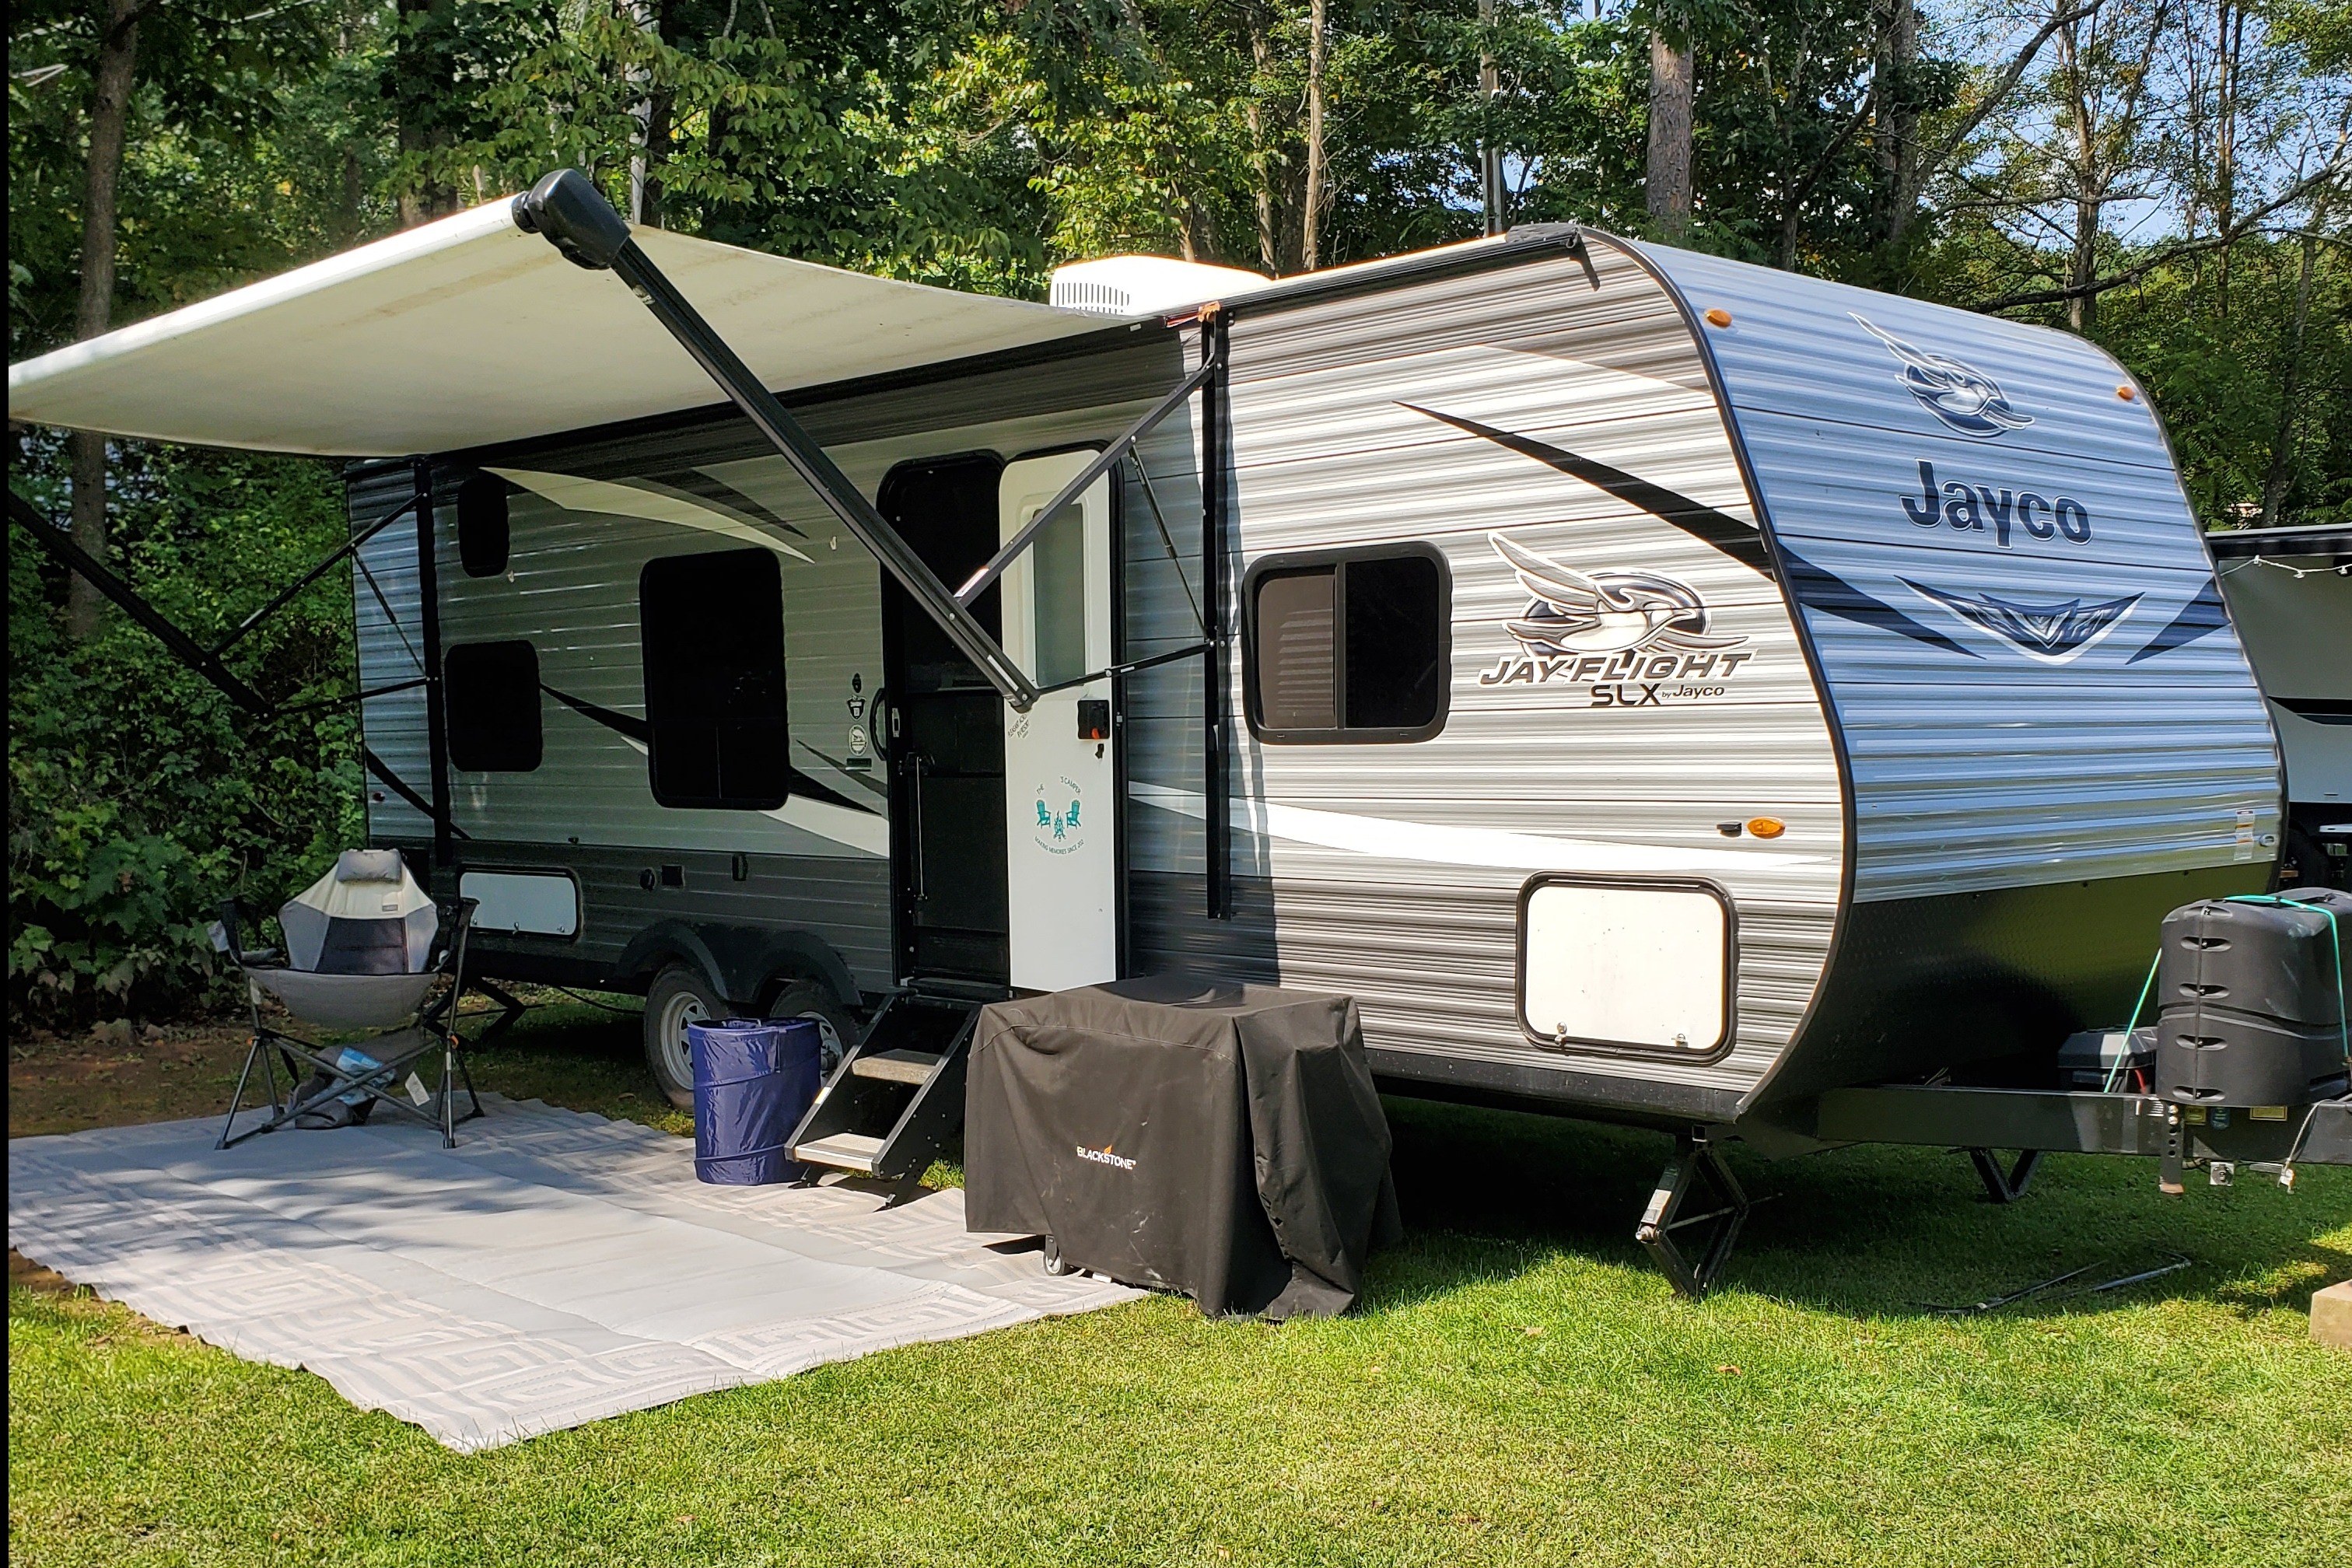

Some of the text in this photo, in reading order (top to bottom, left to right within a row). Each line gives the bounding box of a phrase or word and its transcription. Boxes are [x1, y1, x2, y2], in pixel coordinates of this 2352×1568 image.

[1899, 457, 2093, 549] Jayco
[1591, 683, 1661, 706] SLX
[1673, 684, 1725, 699] Jayco
[1036, 783, 1045, 795] THE
[1034, 835, 1048, 851] MAKING
[1067, 844, 1078, 854] SINCE
[1076, 1146, 1133, 1170] BLACKSTONE
